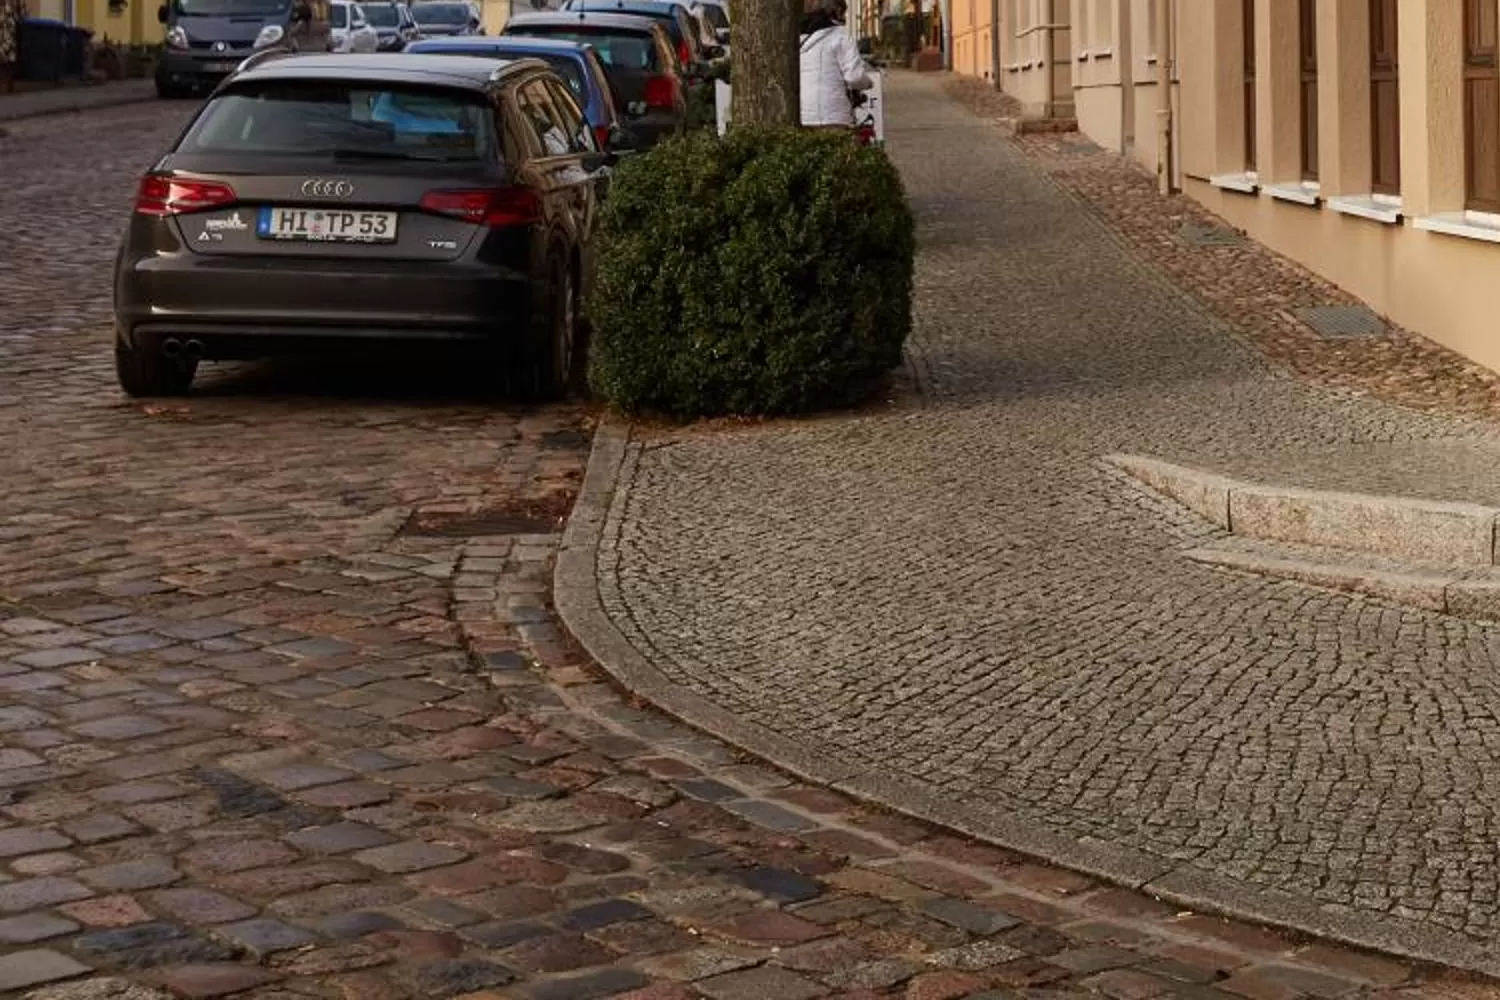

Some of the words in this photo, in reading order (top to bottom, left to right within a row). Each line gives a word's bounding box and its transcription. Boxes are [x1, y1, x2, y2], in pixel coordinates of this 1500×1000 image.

[279, 210, 308, 232] HI
[326, 212, 354, 233] TP
[359, 213, 389, 235] 53
